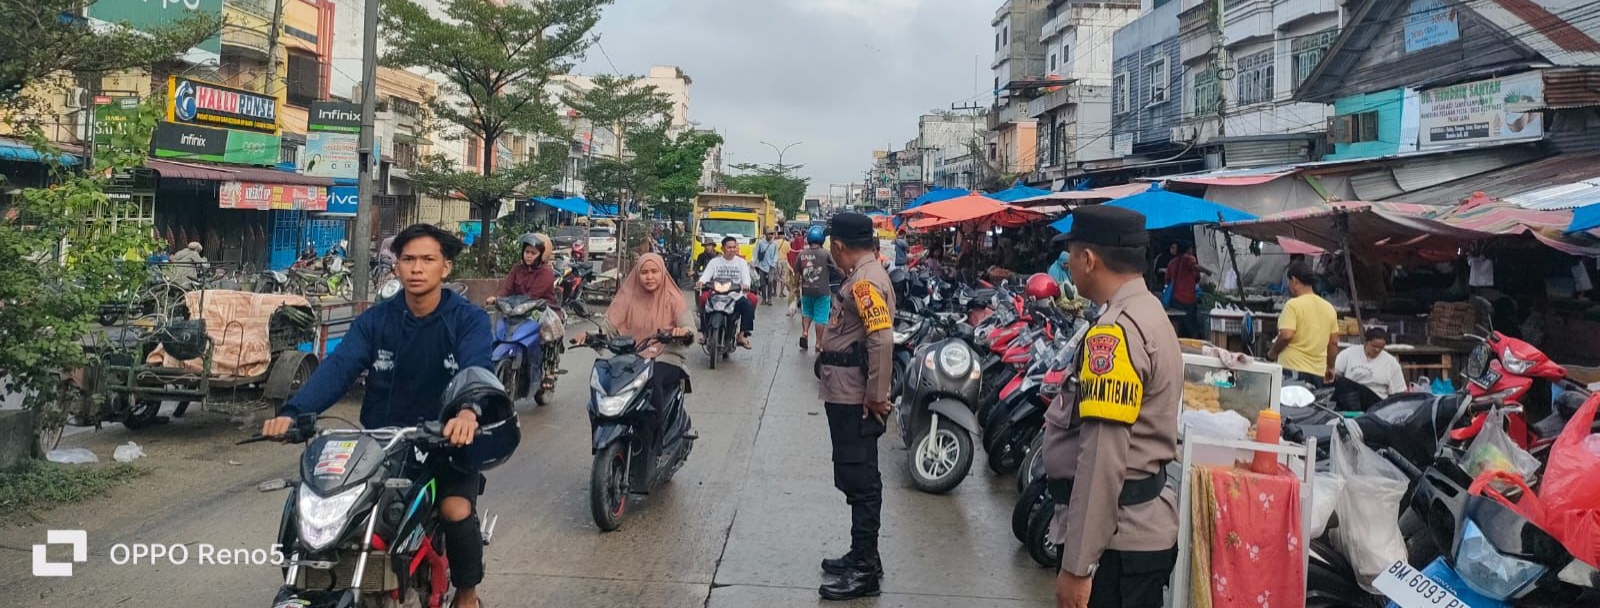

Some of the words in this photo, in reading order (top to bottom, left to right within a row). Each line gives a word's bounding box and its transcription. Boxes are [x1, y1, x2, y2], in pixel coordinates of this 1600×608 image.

[196, 87, 239, 114] HALLO
[318, 109, 361, 121] Infinix
[180, 132, 206, 147] Infinix
[1388, 560, 1412, 581] BM
[1409, 574, 1447, 604] 6093
